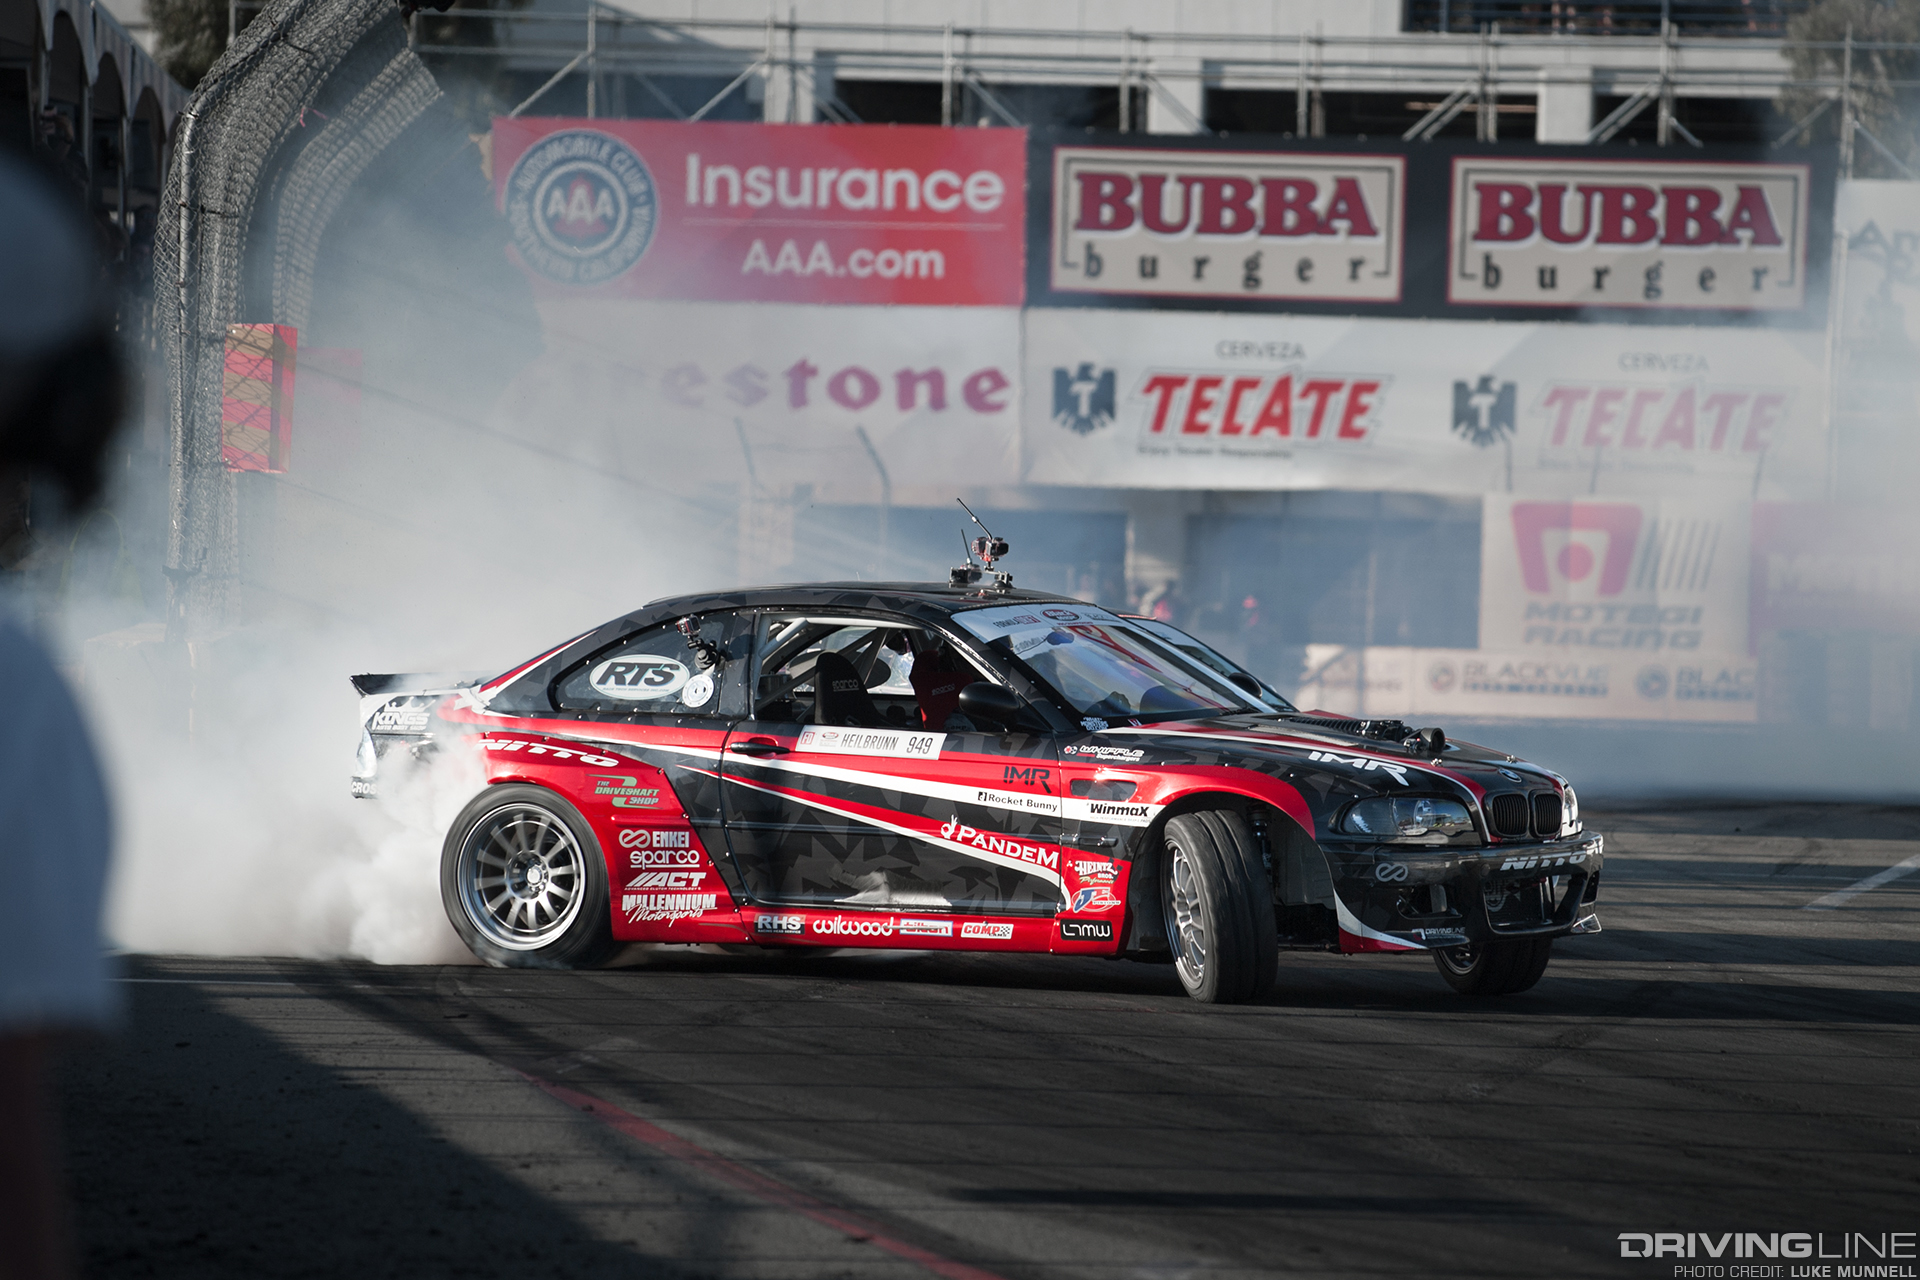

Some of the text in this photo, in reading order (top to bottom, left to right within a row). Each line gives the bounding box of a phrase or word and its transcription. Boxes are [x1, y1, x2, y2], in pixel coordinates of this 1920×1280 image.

[686, 153, 1005, 213] Insurance
[546, 184, 615, 226] AAA
[1073, 171, 1380, 238] BUBBA
[1471, 182, 1783, 247] BUBBA
[742, 238, 945, 279] AAA.com
[1084, 243, 1368, 292] burger
[1481, 252, 1769, 300] burger
[1216, 339, 1306, 362] CERVEZA
[1617, 351, 1710, 373] CERVEZA
[1524, 600, 1705, 625] MOTEGI
[596, 662, 681, 687] RTS
[1463, 660, 1610, 682] BLACKVUE
[832, 679, 859, 691] sparco
[372, 711, 430, 730] KINGS
[475, 739, 619, 768] NITTO
[840, 733, 899, 751] HEILBRUNN
[906, 736, 934, 755] 949
[1003, 766, 1052, 794] IMR
[1308, 751, 1410, 787] IMR
[594, 787, 660, 797] DRIVESHAFT
[628, 796, 660, 805] SHOP
[988, 792, 1058, 813] Rocket Bunny
[652, 831, 690, 848] ENKEI
[956, 824, 1060, 870] PANDEM
[629, 849, 700, 870] sparco
[1074, 860, 1118, 876] HEINTZ
[1500, 850, 1587, 871] NITTO
[621, 893, 717, 911] MILLENNIUM
[625, 903, 718, 928] Motorsports
[757, 915, 801, 930] RHS
[812, 914, 894, 936] wilwood
[963, 924, 1001, 935] COMP
